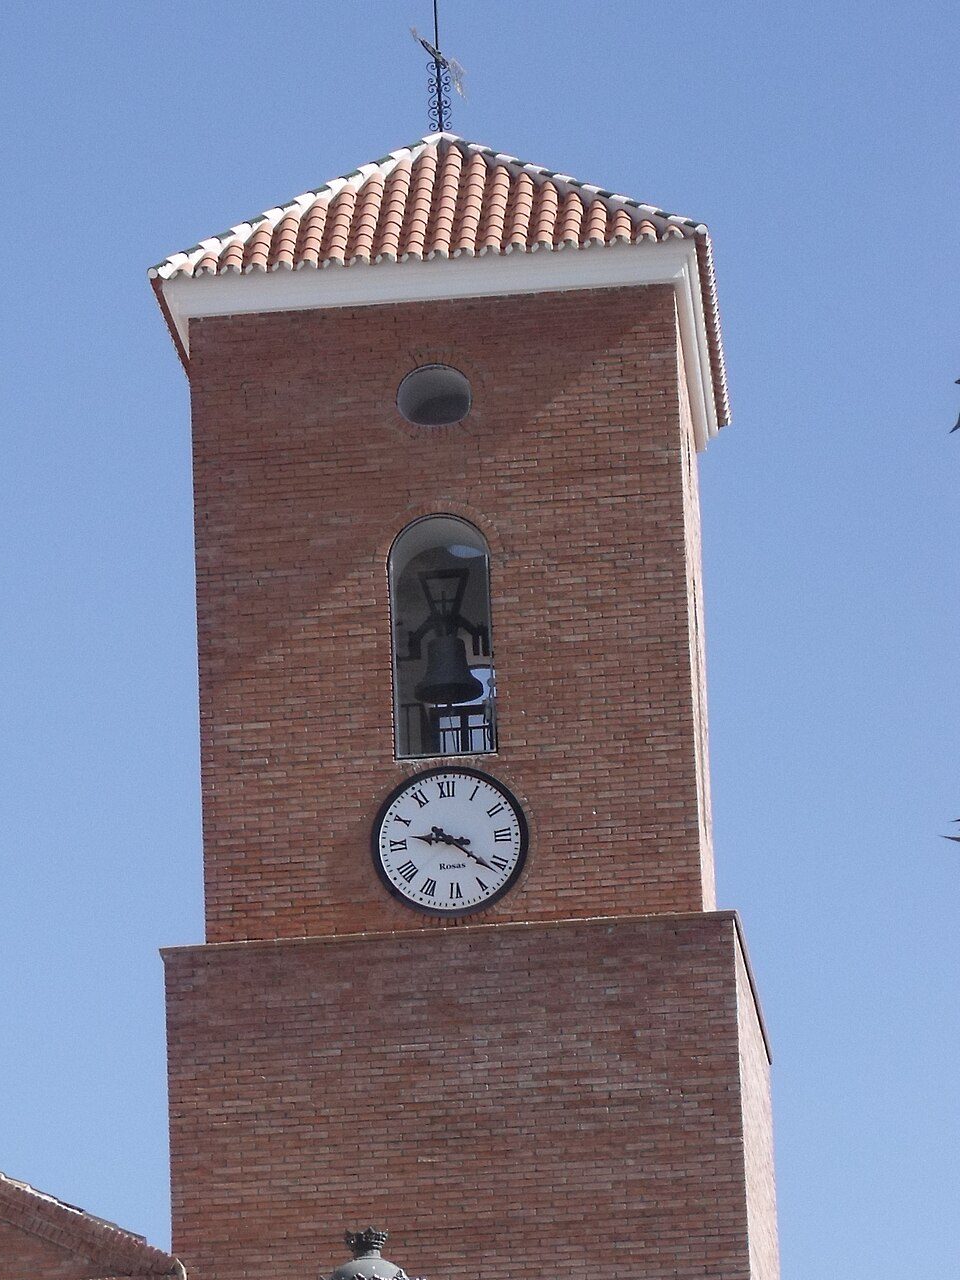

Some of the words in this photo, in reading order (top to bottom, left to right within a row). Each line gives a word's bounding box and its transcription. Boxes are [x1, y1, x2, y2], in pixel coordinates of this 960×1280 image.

[437, 780, 456, 798] XII
[469, 785, 479, 801] I
[410, 789, 430, 808] XI
[487, 802, 504, 818] II
[393, 814, 411, 827] X
[494, 827, 512, 842] III
[389, 838, 407, 852] IX
[439, 862, 466, 871] Rosas
[490, 854, 508, 871] IV
[396, 859, 419, 883] VIII
[420, 877, 437, 897] VII
[449, 882, 463, 899] VI
[475, 876, 489, 892] V
